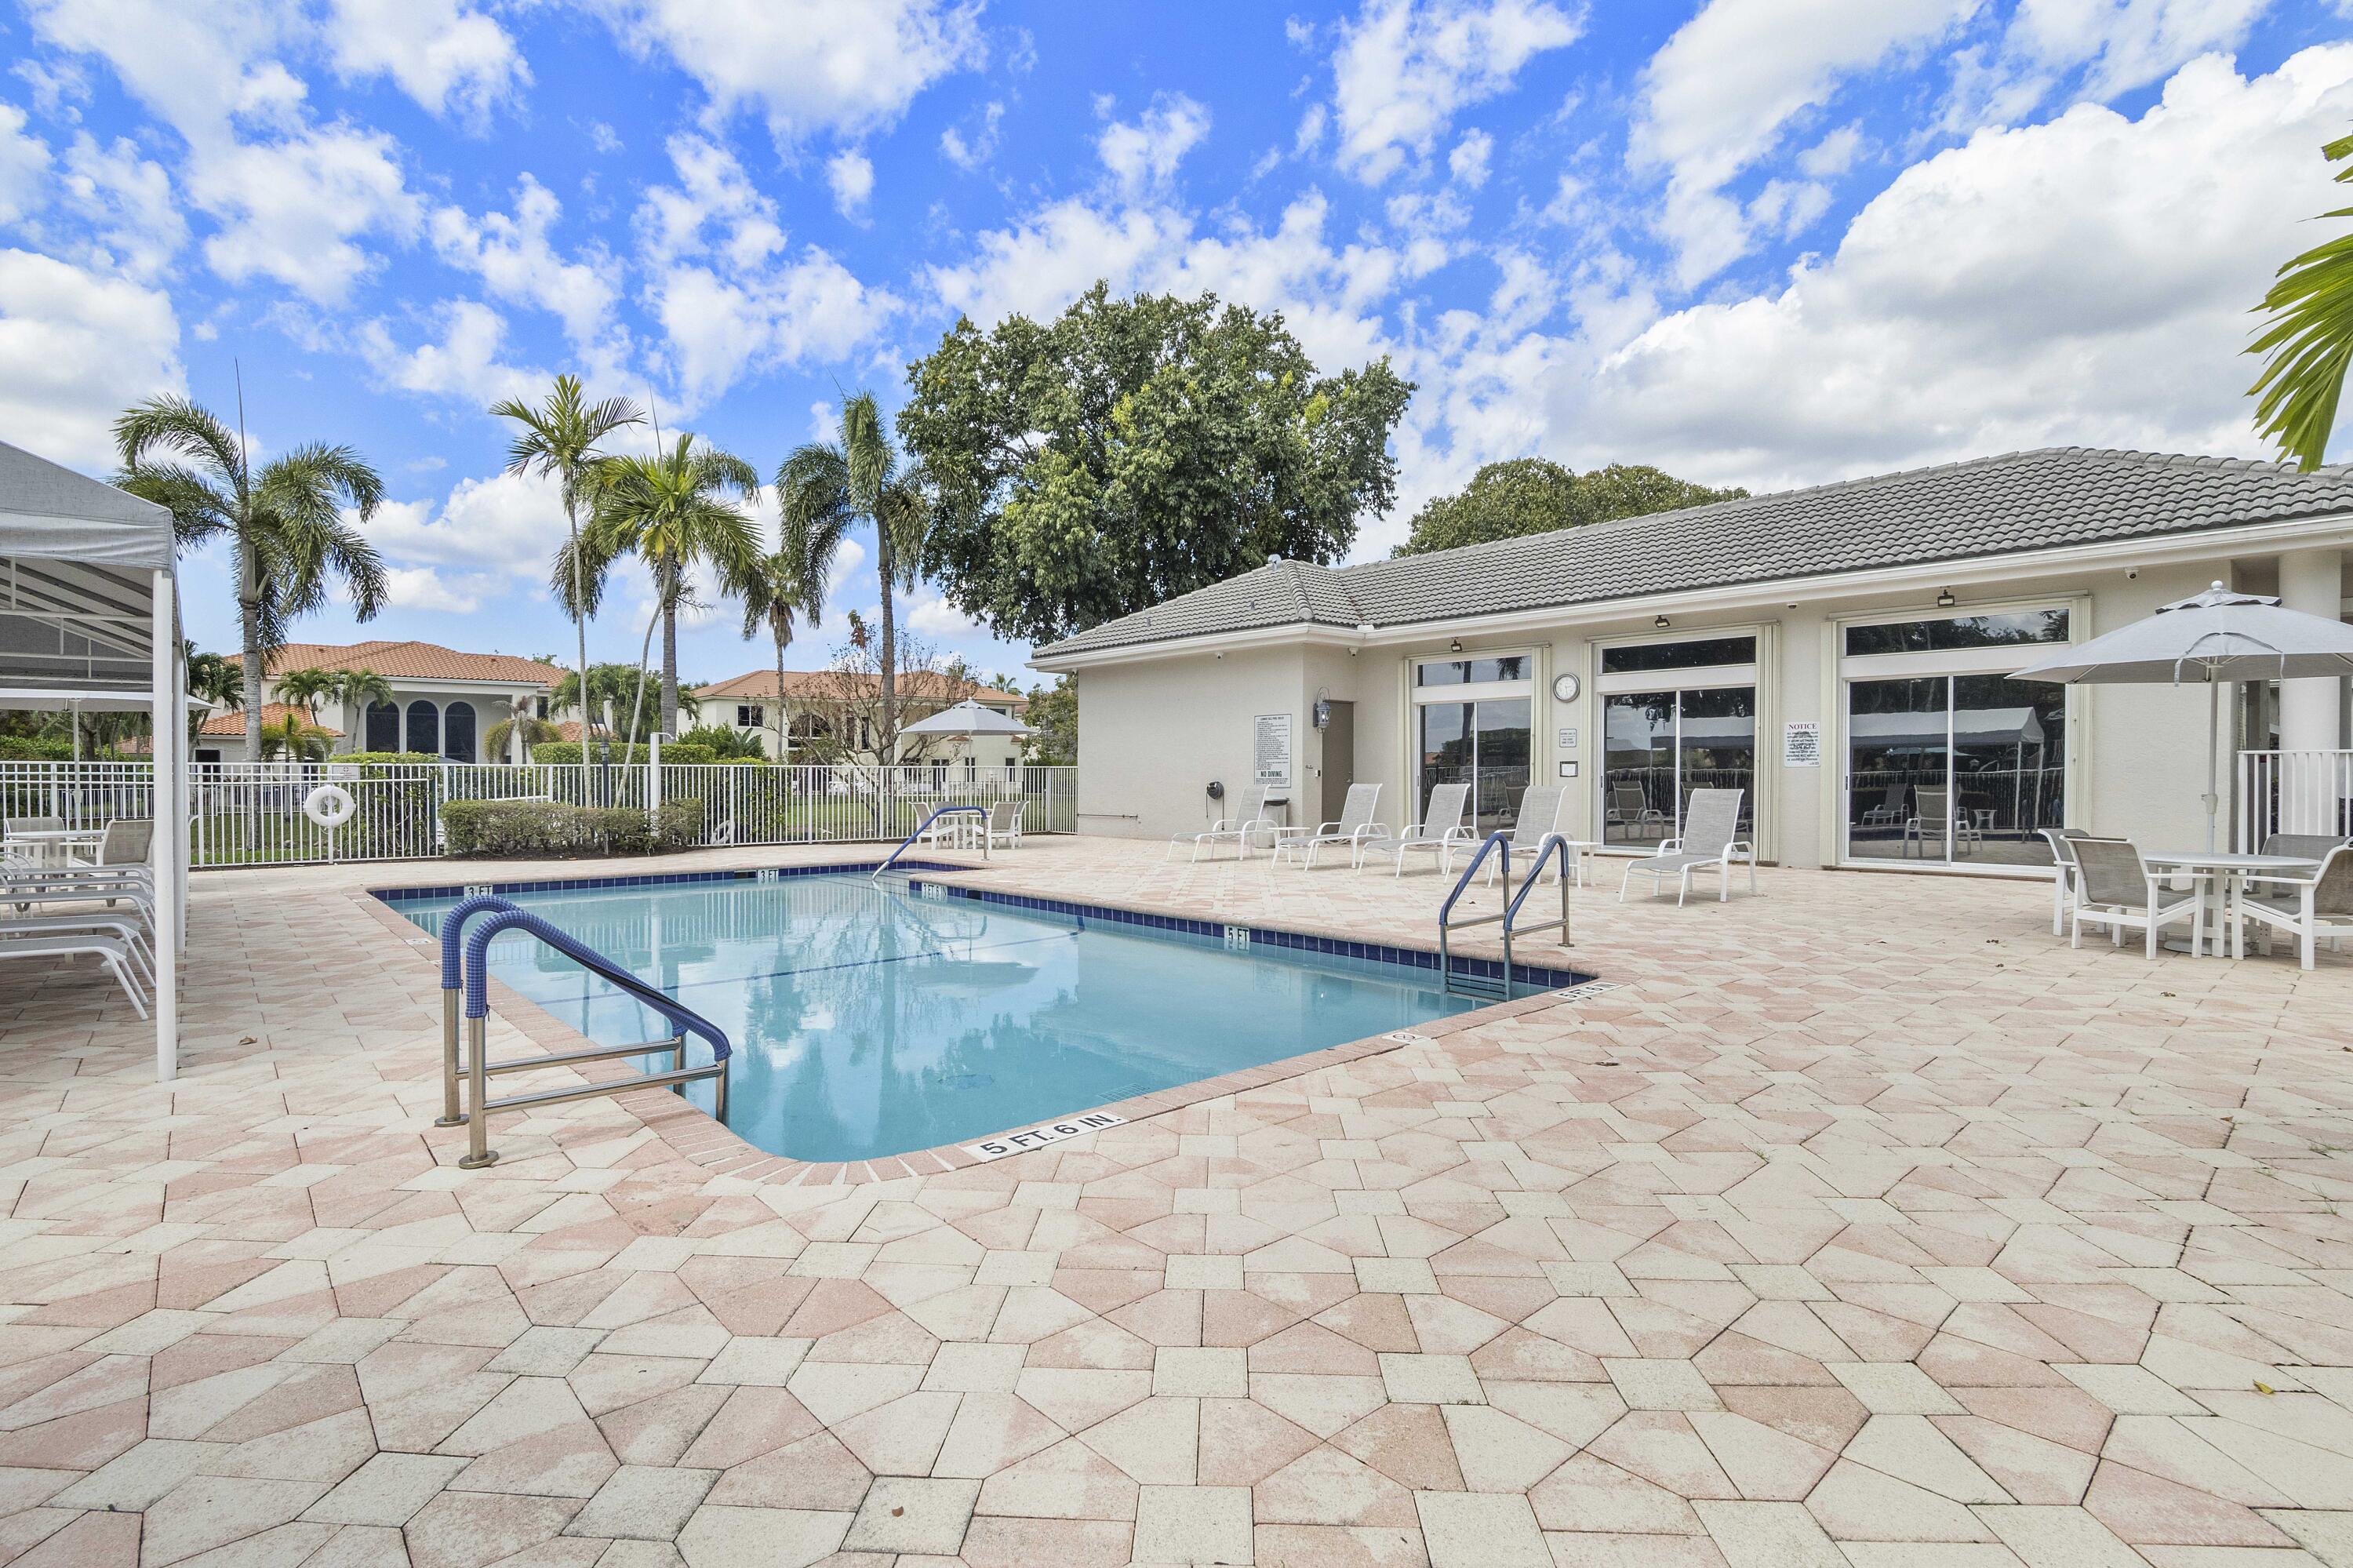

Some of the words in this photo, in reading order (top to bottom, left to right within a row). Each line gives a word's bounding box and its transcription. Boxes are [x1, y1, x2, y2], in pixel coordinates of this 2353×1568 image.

[768, 869, 778, 879] FT
[468, 886, 475, 897] 3
[478, 885, 492, 896] FT
[1228, 927, 1234, 940] 5
[1237, 928, 1249, 942] FT
[980, 1141, 1008, 1155] 5
[1009, 1130, 1054, 1147] FT.
[1054, 1124, 1079, 1134] 6
[1078, 1114, 1122, 1128] IN.
